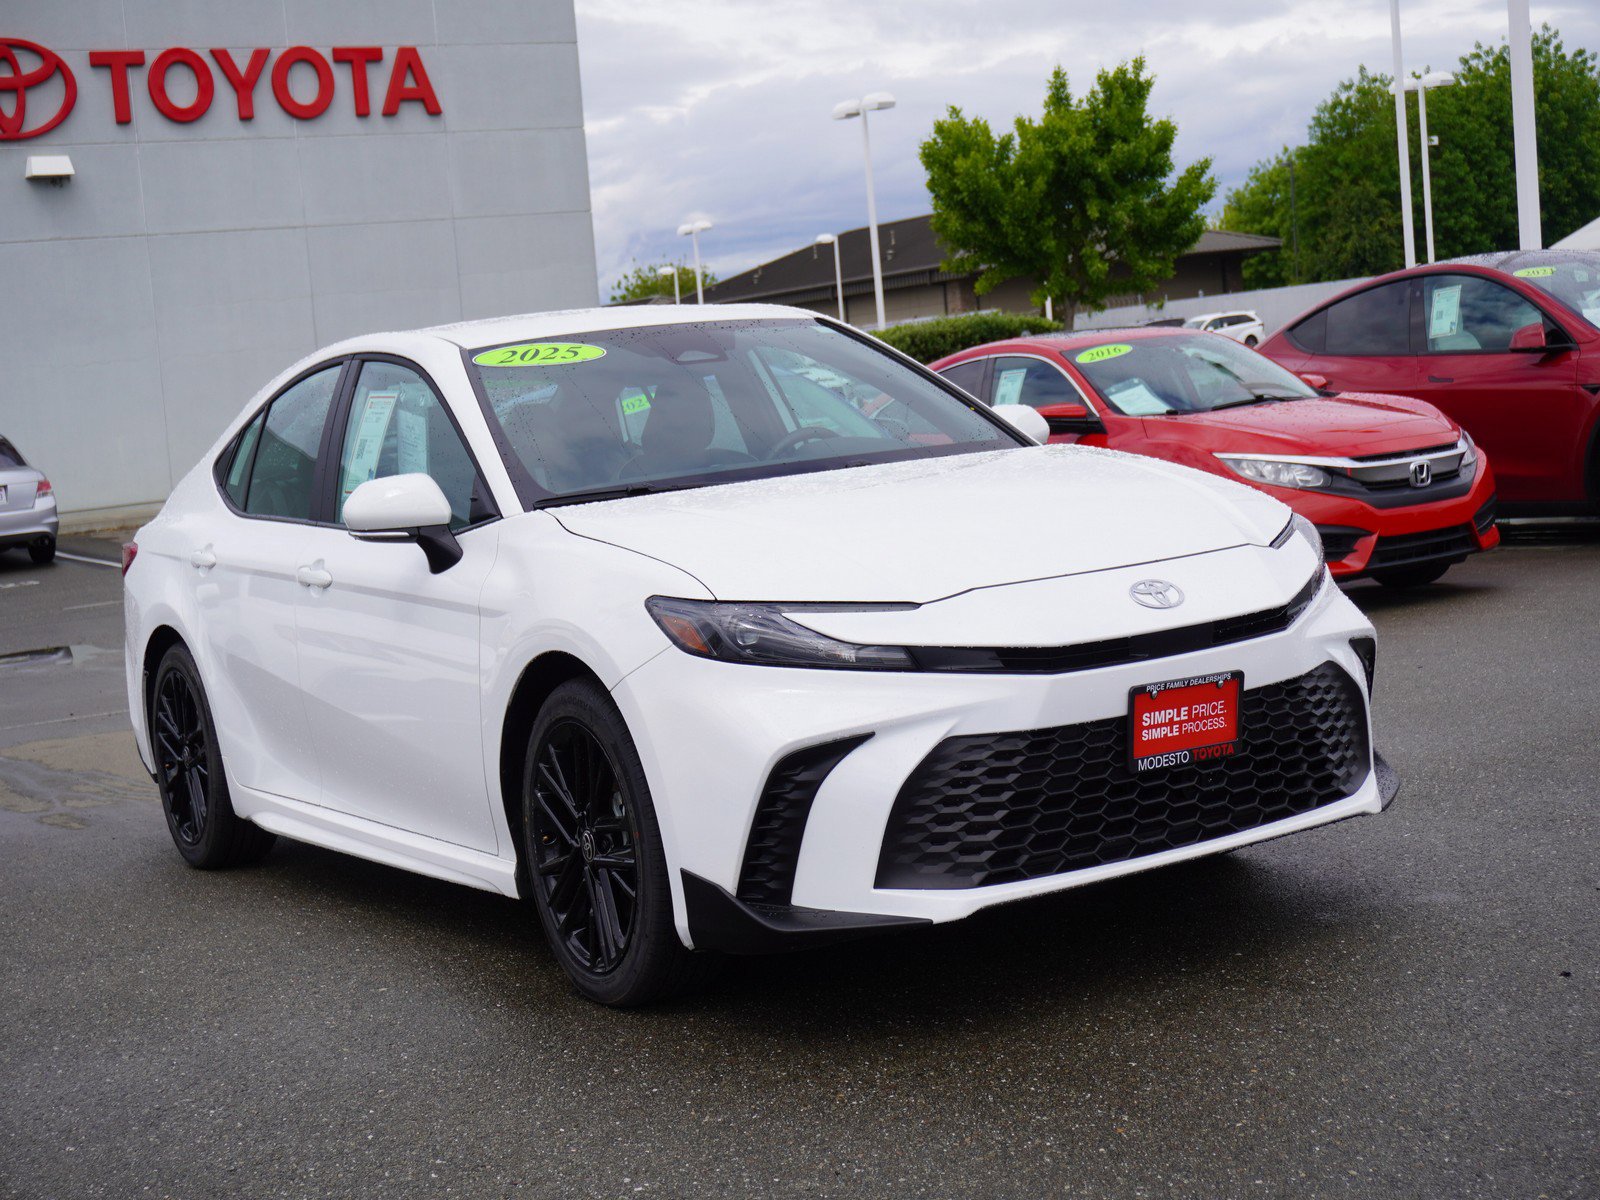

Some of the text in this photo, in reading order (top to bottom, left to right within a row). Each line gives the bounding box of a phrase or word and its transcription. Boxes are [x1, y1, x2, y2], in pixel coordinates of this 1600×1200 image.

[89, 46, 442, 125] TOYOTA
[497, 347, 582, 364] 2025
[1087, 346, 1121, 361] 2016
[1146, 673, 1231, 693] PRICE FAMILY DEALERSHIPS
[1142, 700, 1227, 727] SIMPLE PRICE.
[1141, 717, 1227, 741] SIMPLE PROCESS.
[1138, 743, 1235, 771] MODESTO TOYOTA
